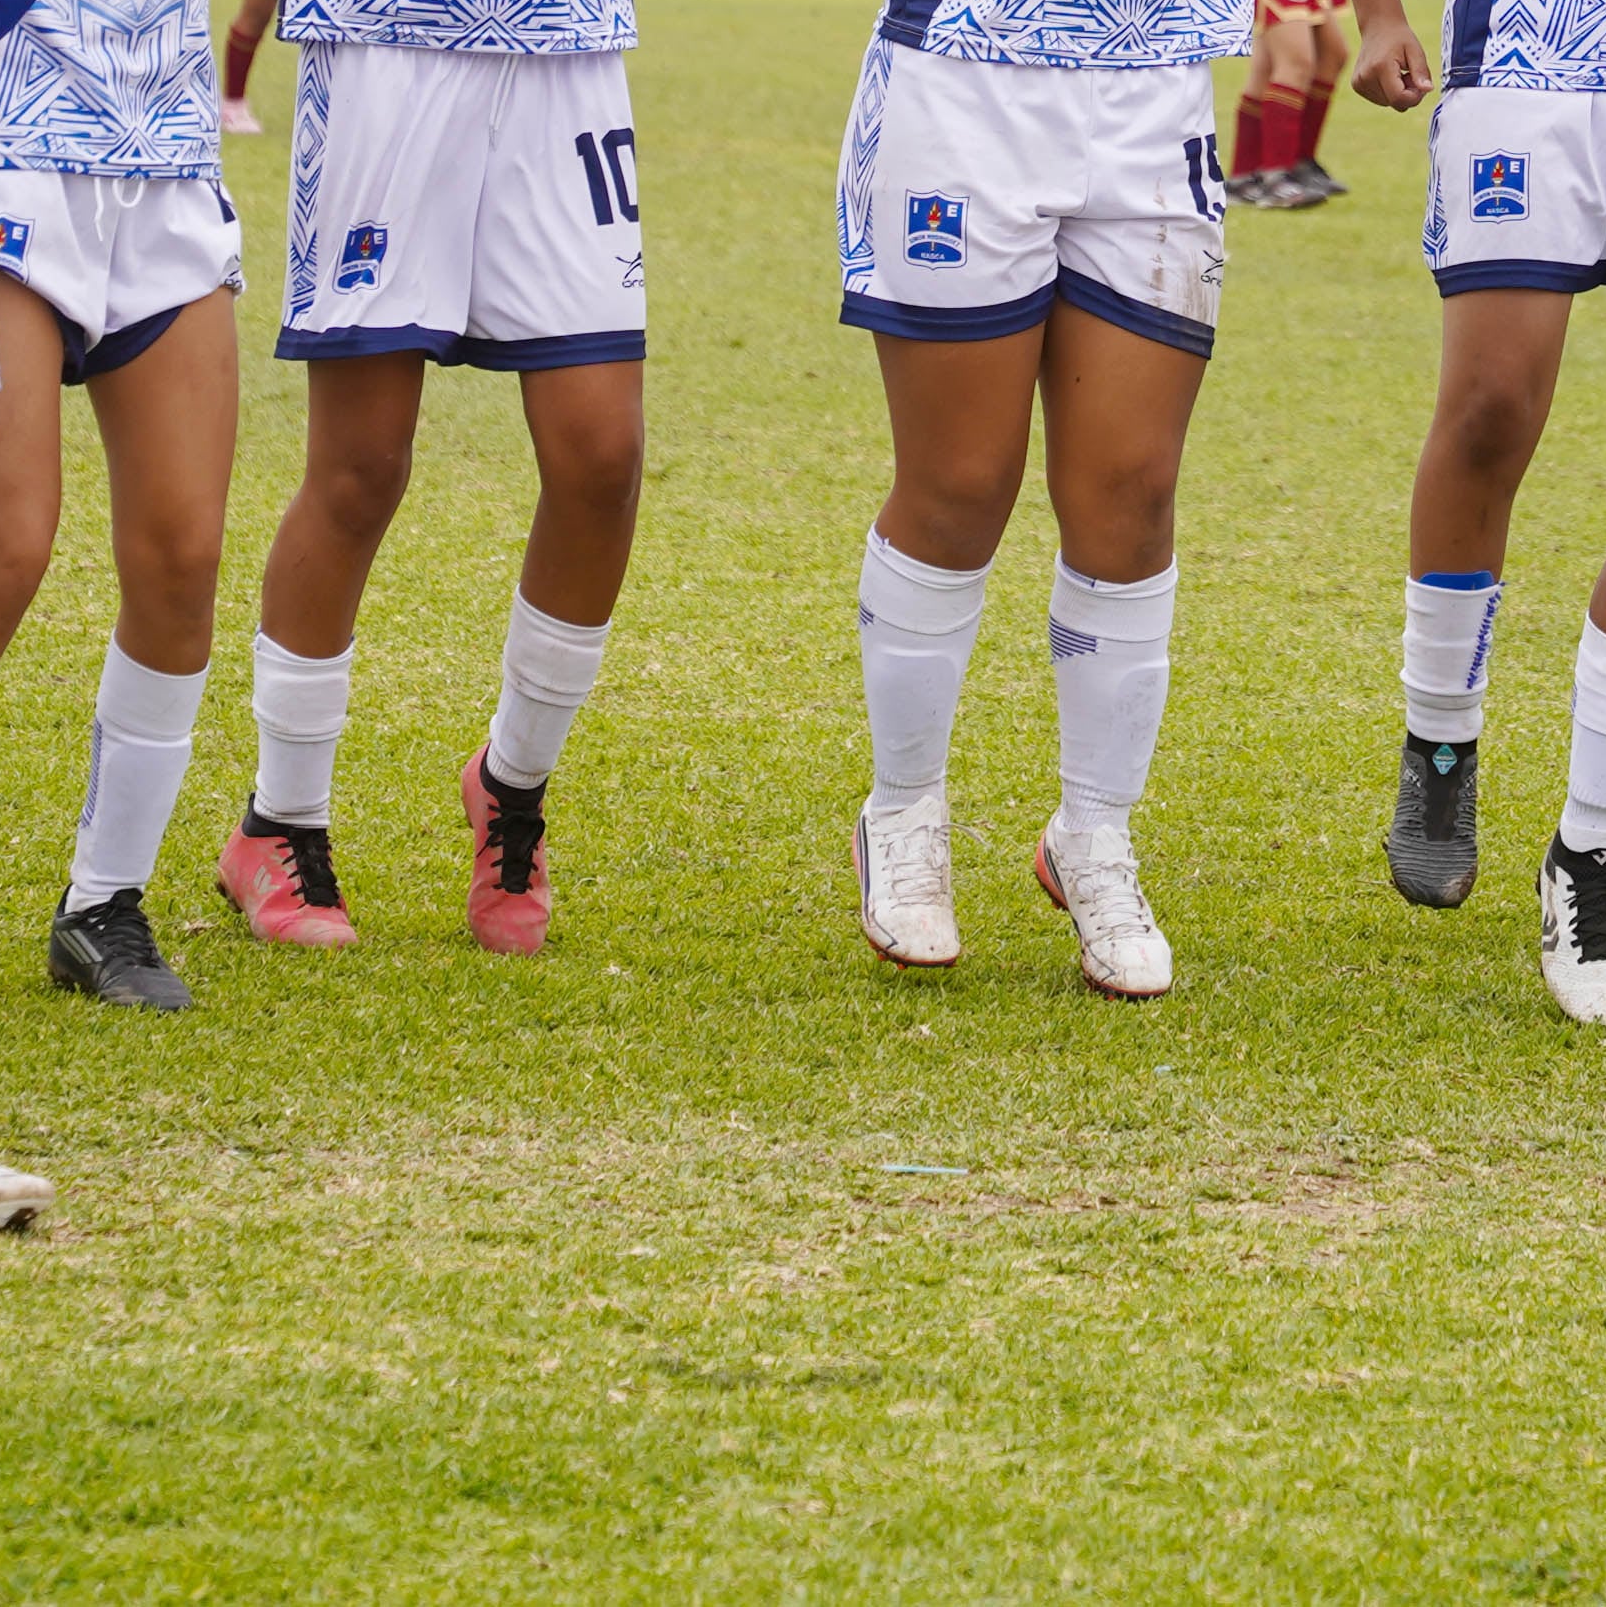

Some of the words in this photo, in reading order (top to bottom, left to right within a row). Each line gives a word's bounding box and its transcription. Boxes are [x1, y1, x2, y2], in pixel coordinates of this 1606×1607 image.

[1510, 161, 1521, 173] E
[574, 128, 640, 226] 10
[946, 204, 959, 218] E
[374, 232, 385, 246] E
